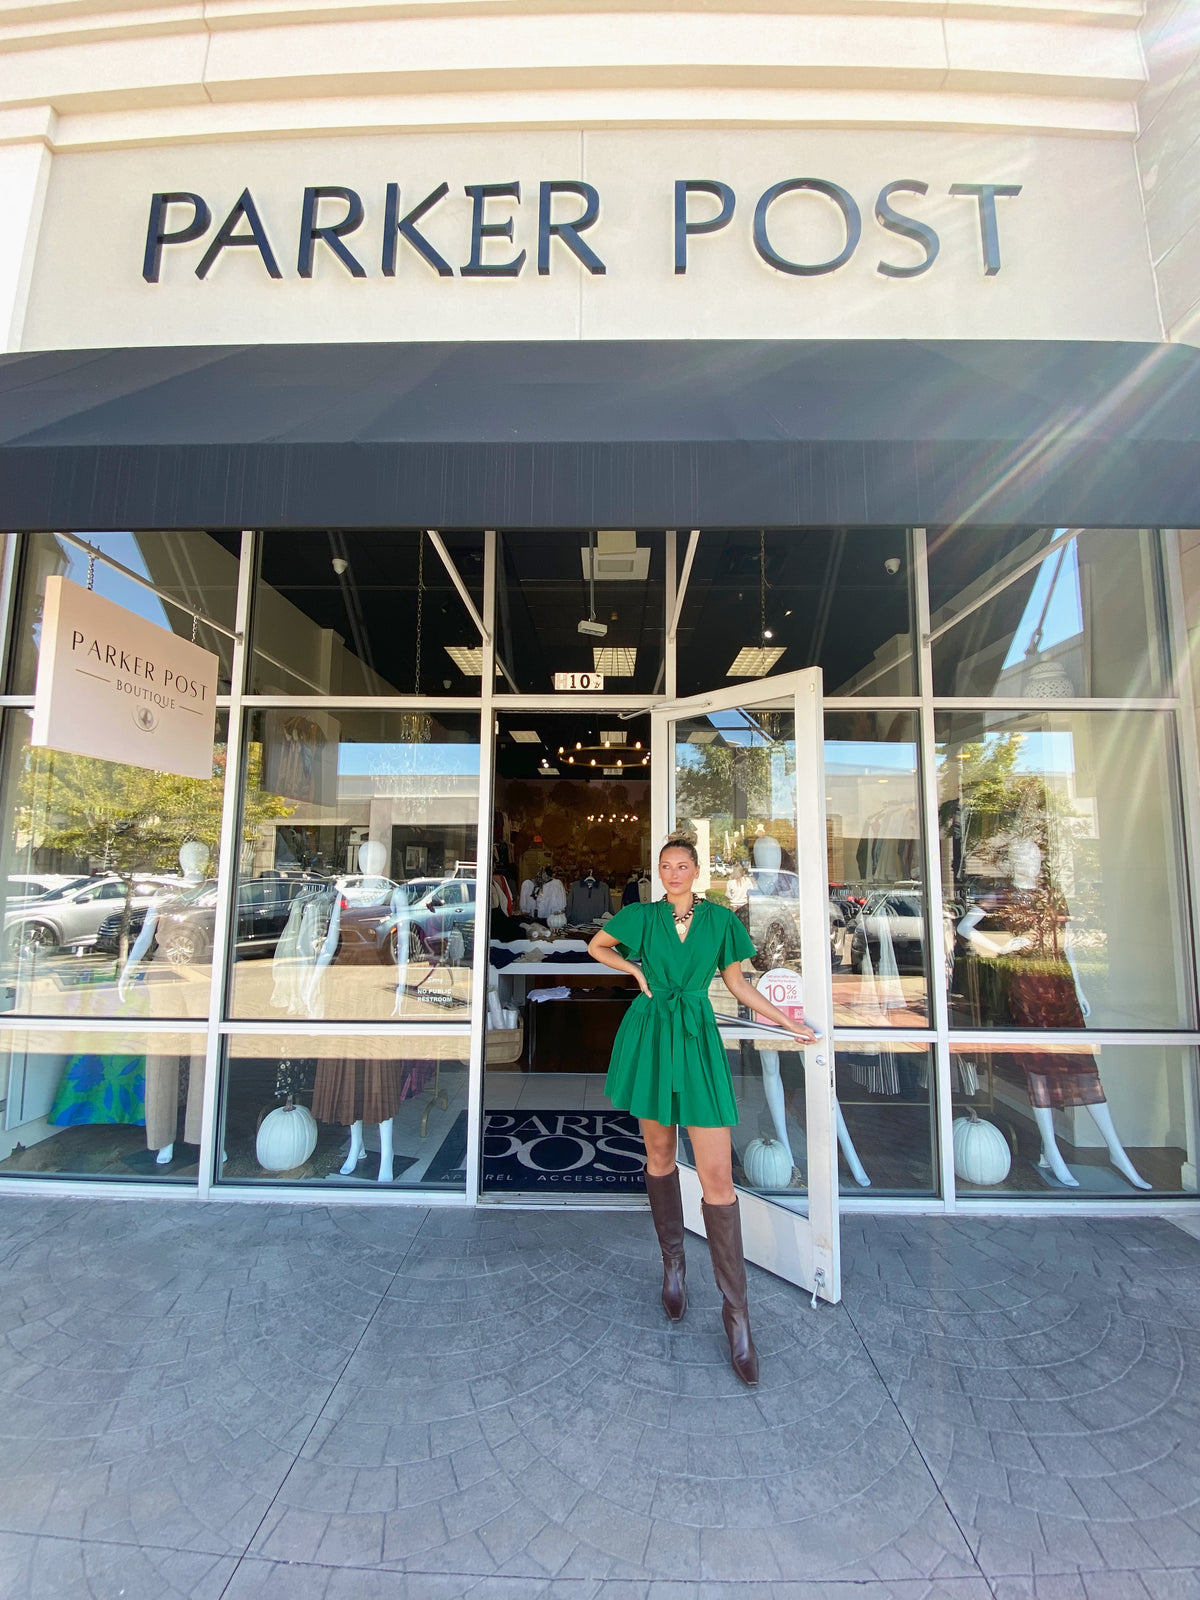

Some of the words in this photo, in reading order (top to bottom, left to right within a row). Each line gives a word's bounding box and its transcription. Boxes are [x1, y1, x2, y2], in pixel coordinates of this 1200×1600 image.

[143, 181, 607, 283] PARKER
[674, 177, 1024, 279] POST
[71, 630, 155, 682] PARKER
[164, 668, 208, 701] POST
[116, 679, 176, 710] BOUTIQUE
[484, 1115, 644, 1136] PARK
[450, 1135, 648, 1173] POS
[537, 1174, 645, 1183] ACCESSORIE
